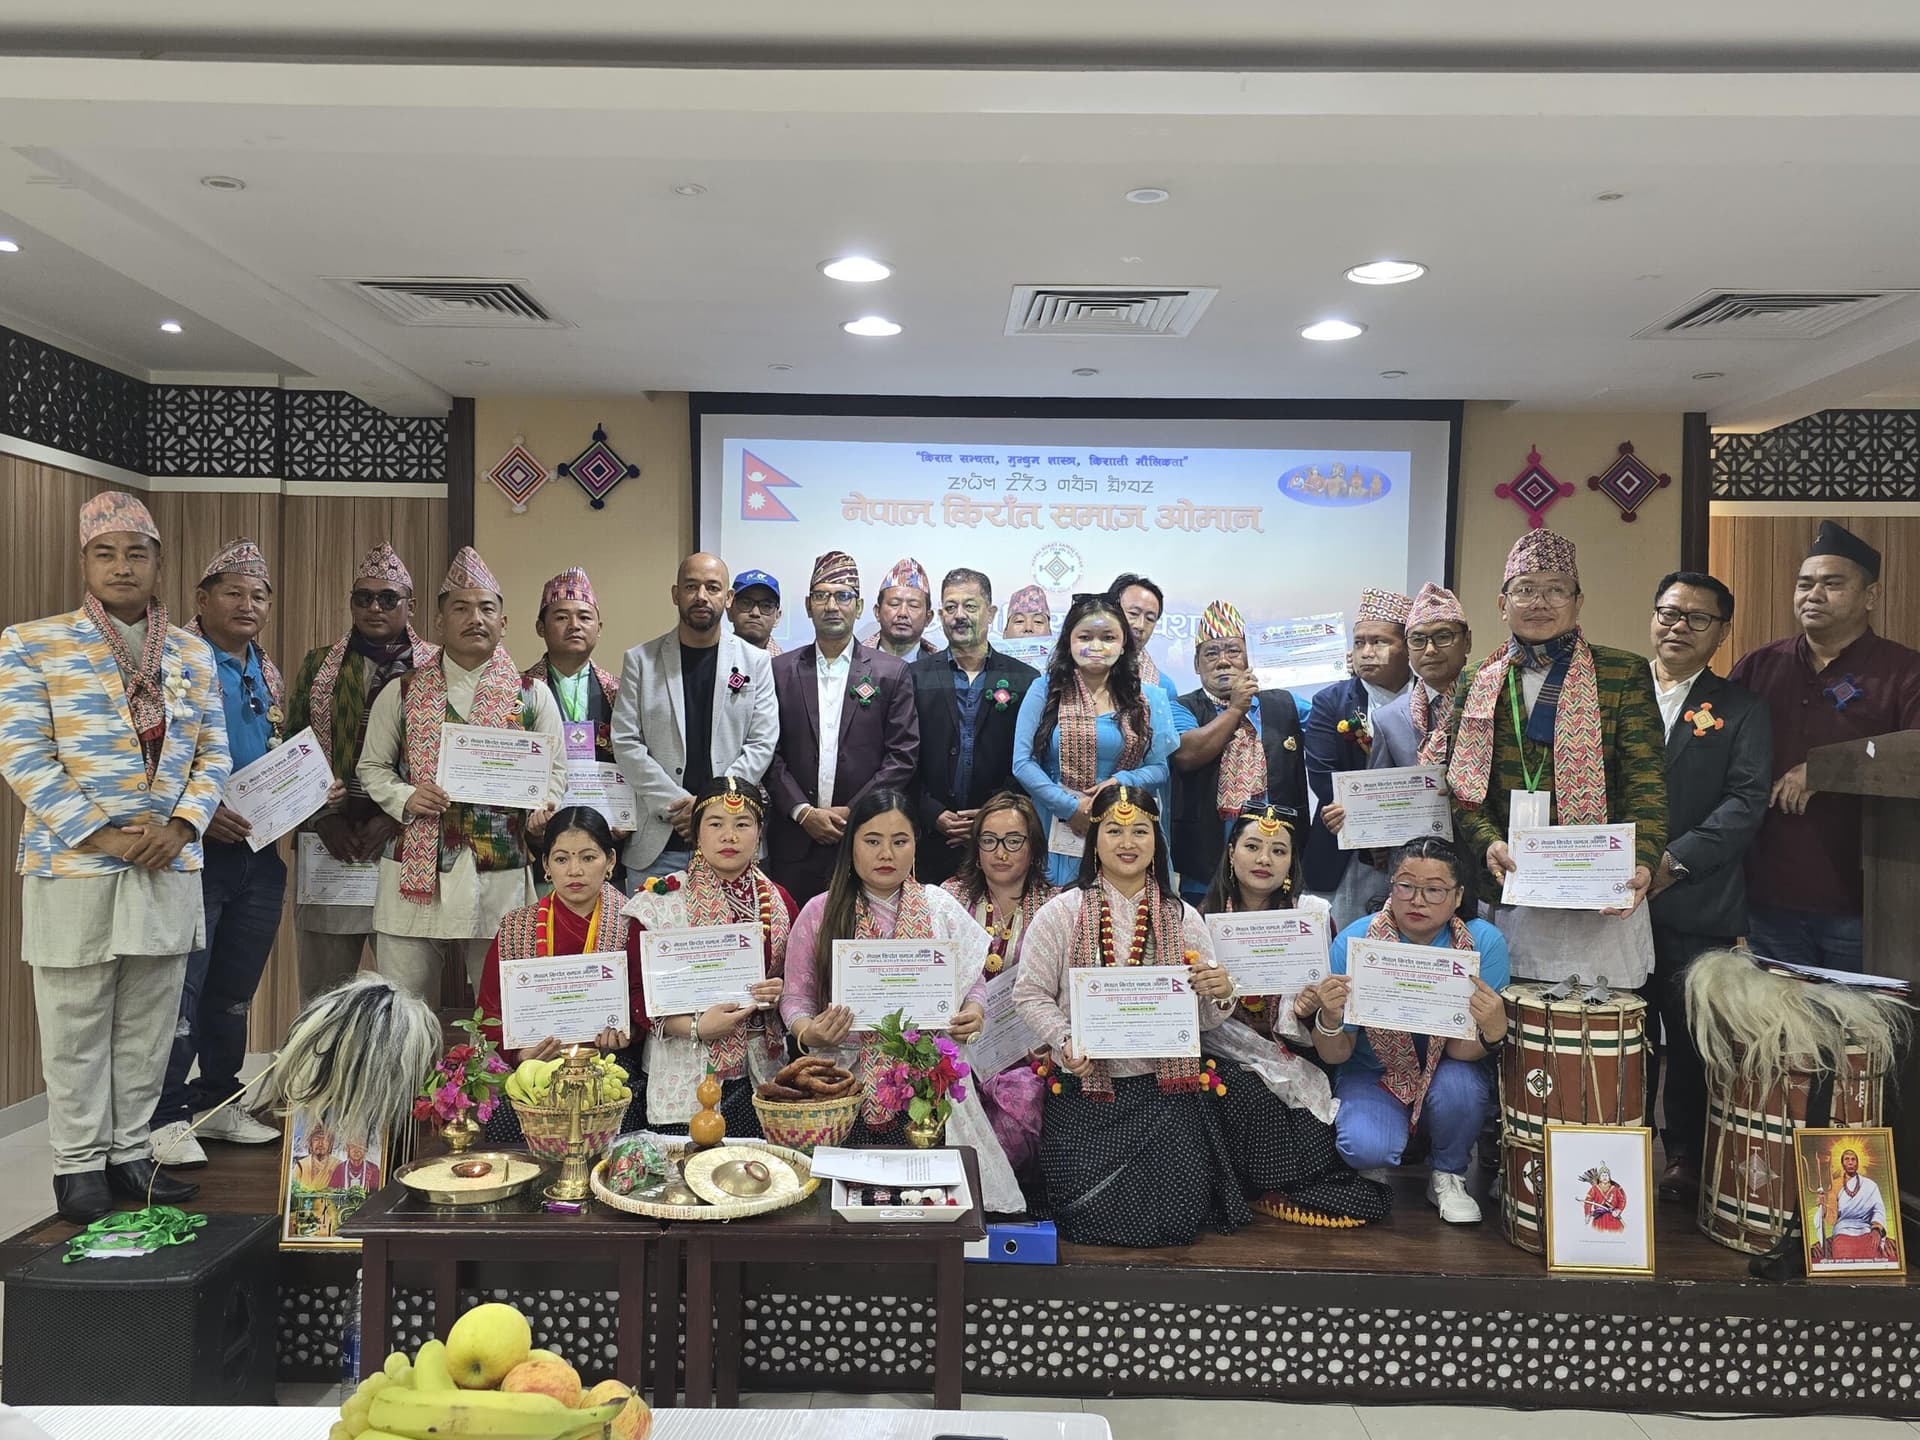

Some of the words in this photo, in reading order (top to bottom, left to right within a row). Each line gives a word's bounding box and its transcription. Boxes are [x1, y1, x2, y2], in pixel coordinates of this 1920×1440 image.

[841, 490, 937, 528] नेपाल
[941, 493, 1045, 530] किराँत
[1049, 503, 1150, 532] समाज
[1154, 498, 1265, 533] ओमान
